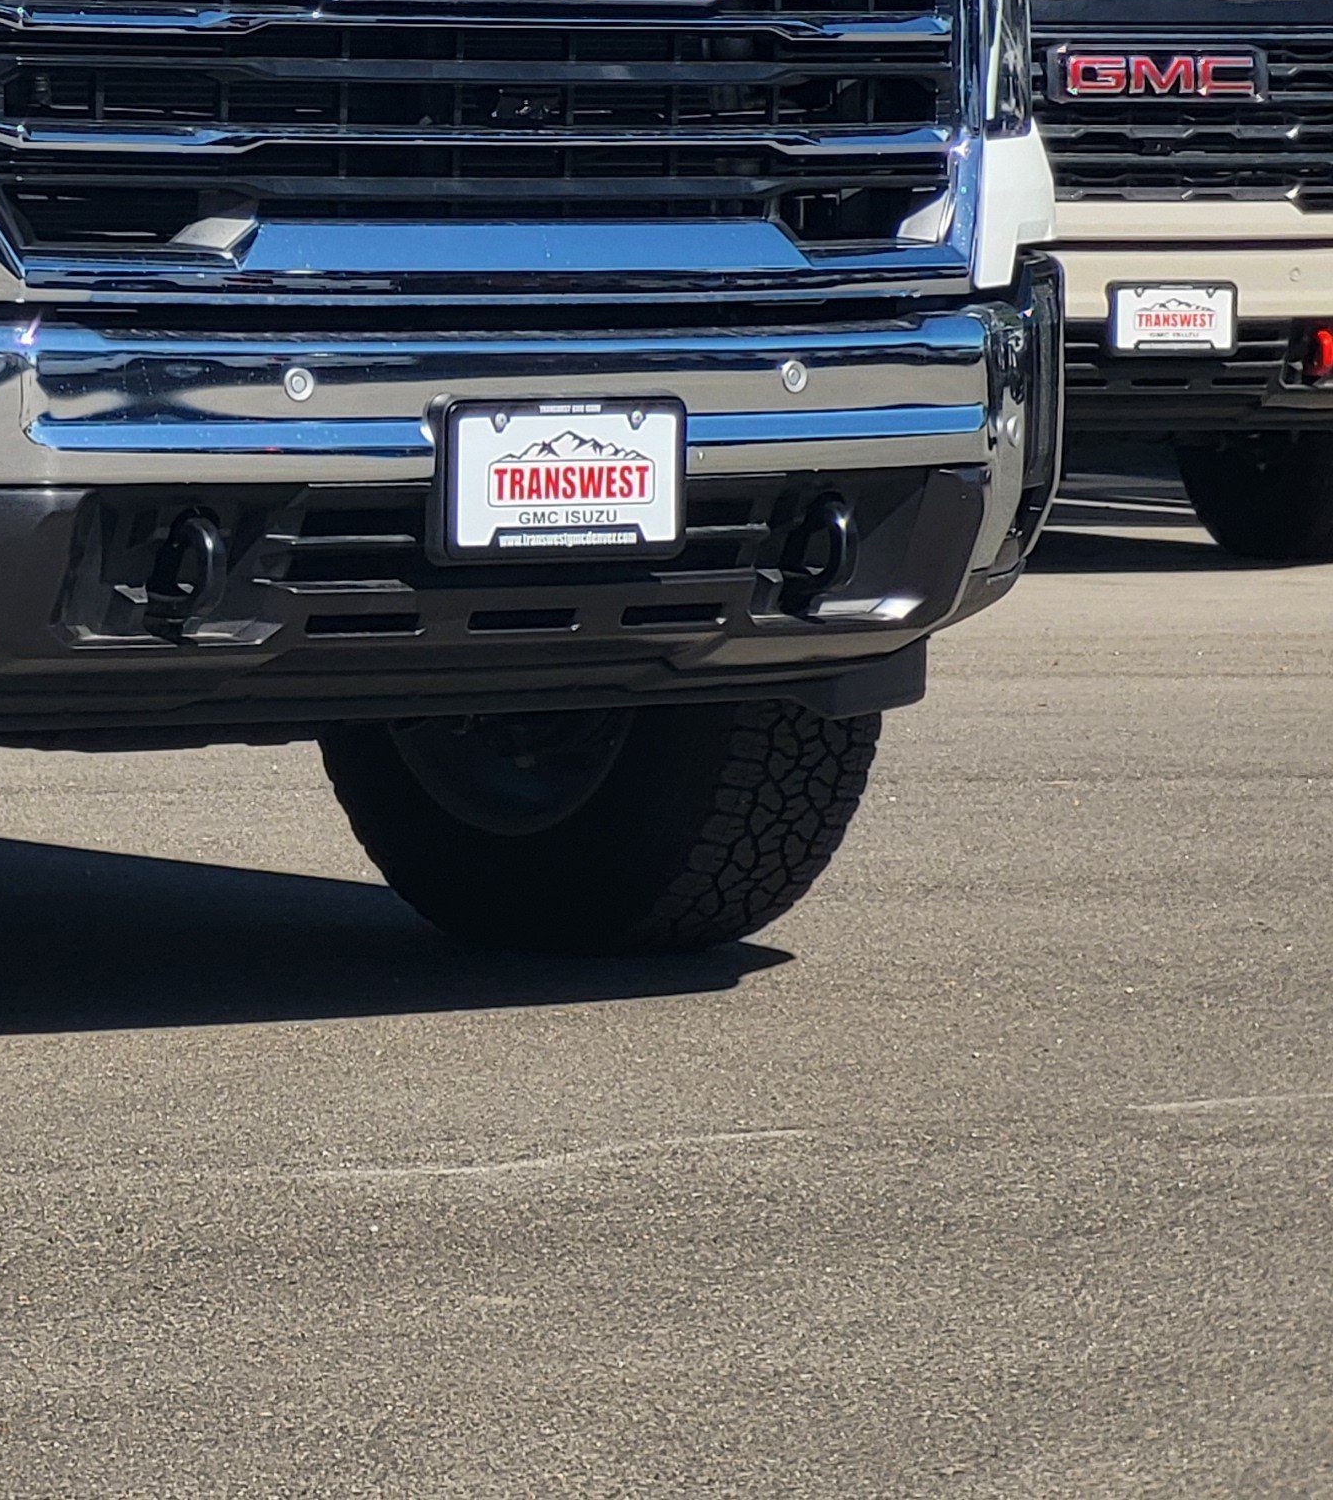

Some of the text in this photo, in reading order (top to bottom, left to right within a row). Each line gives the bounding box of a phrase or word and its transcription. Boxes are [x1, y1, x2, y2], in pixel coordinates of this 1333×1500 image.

[1066, 55, 1255, 96] GMC
[1136, 313, 1215, 328] TRANSWEST
[494, 465, 650, 501] TRANSWEST
[519, 510, 618, 525] GMC ISUZU
[498, 531, 638, 548] www.transwestgmcdenver.com
